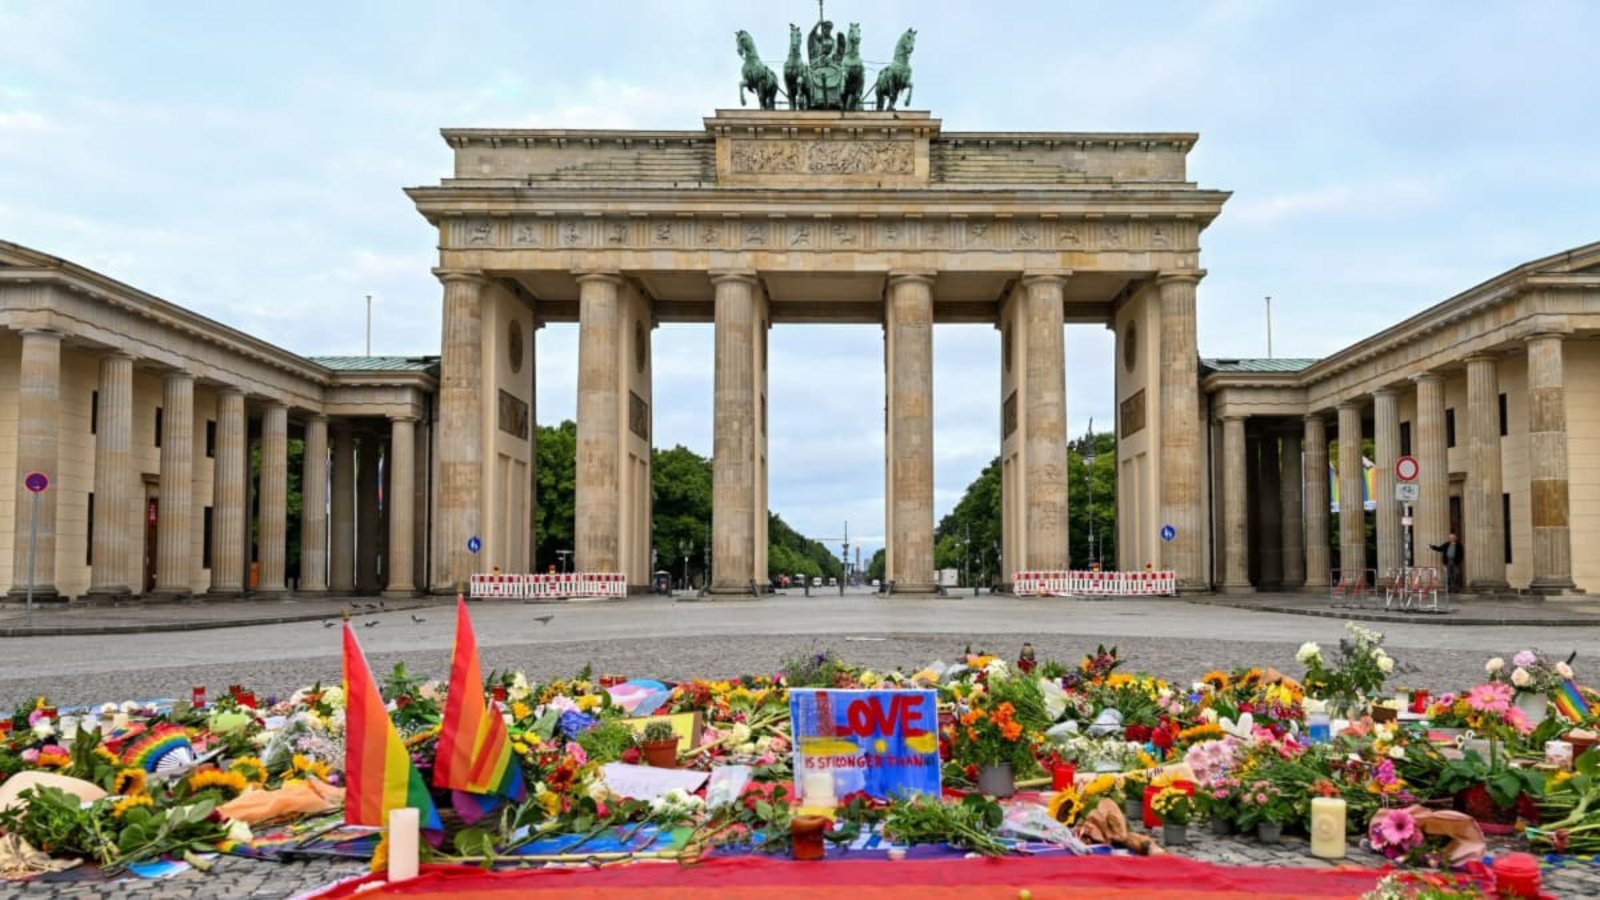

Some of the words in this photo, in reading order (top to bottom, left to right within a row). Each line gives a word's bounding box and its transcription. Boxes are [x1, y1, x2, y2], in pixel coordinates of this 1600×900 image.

[816, 691, 928, 737] LOVE
[805, 756, 815, 769] IS
[818, 755, 883, 769] STRONGER
